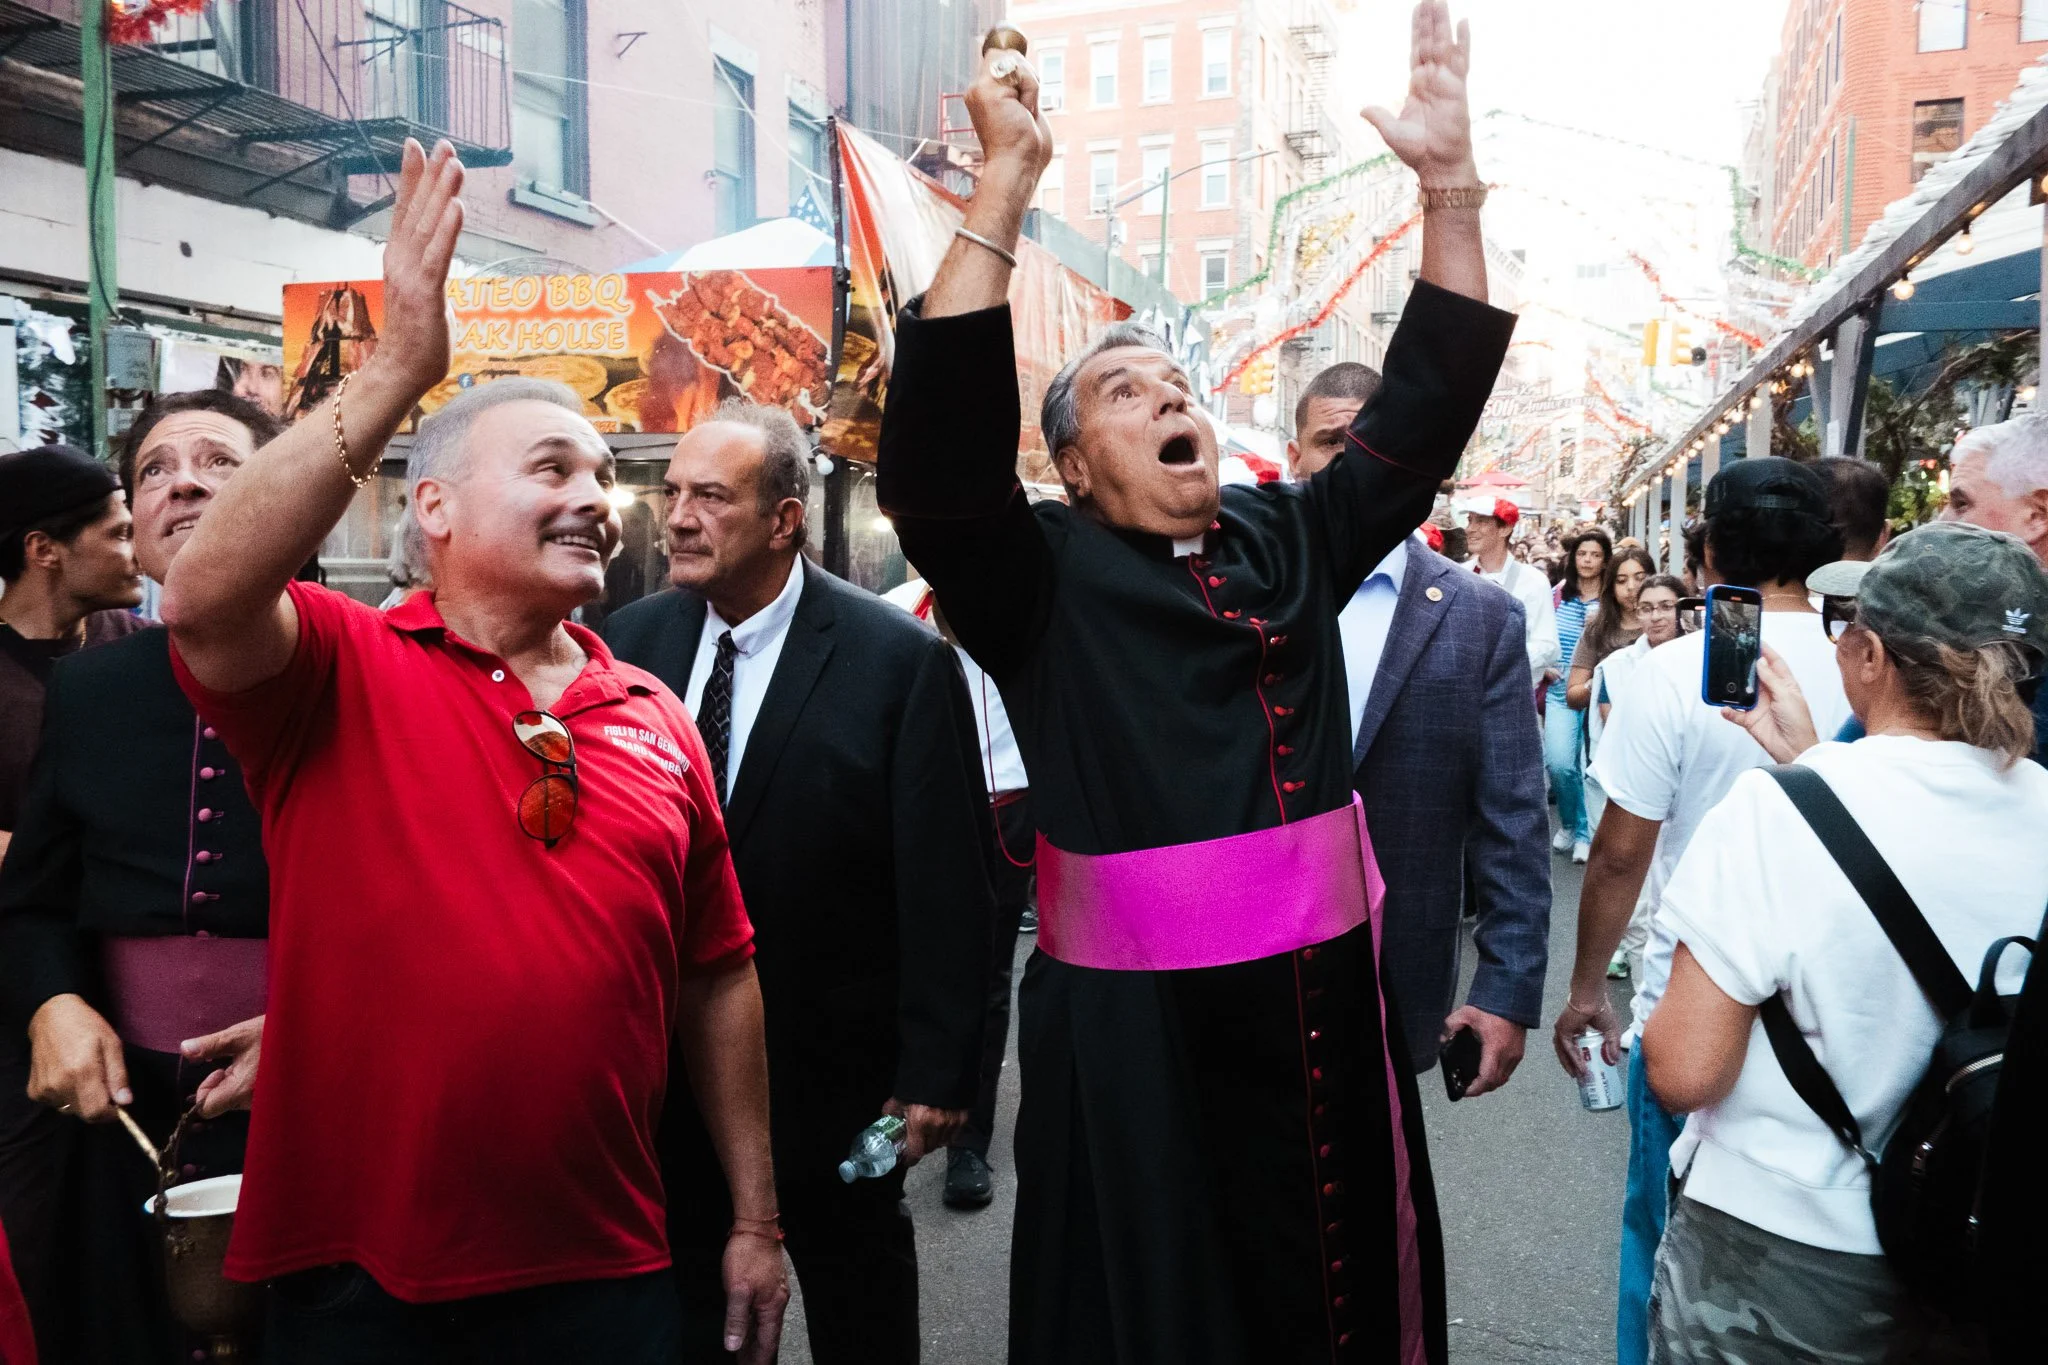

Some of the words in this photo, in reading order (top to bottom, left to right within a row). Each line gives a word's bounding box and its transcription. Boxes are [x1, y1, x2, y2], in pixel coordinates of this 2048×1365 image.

[447, 274, 537, 307] ATEO
[549, 274, 631, 312] BBQ
[517, 322, 625, 351] HOUSE
[603, 725, 627, 736] FIGLI
[627, 726, 637, 739] DI
[638, 728, 657, 745] SAN
[611, 737, 648, 756] BOARD
